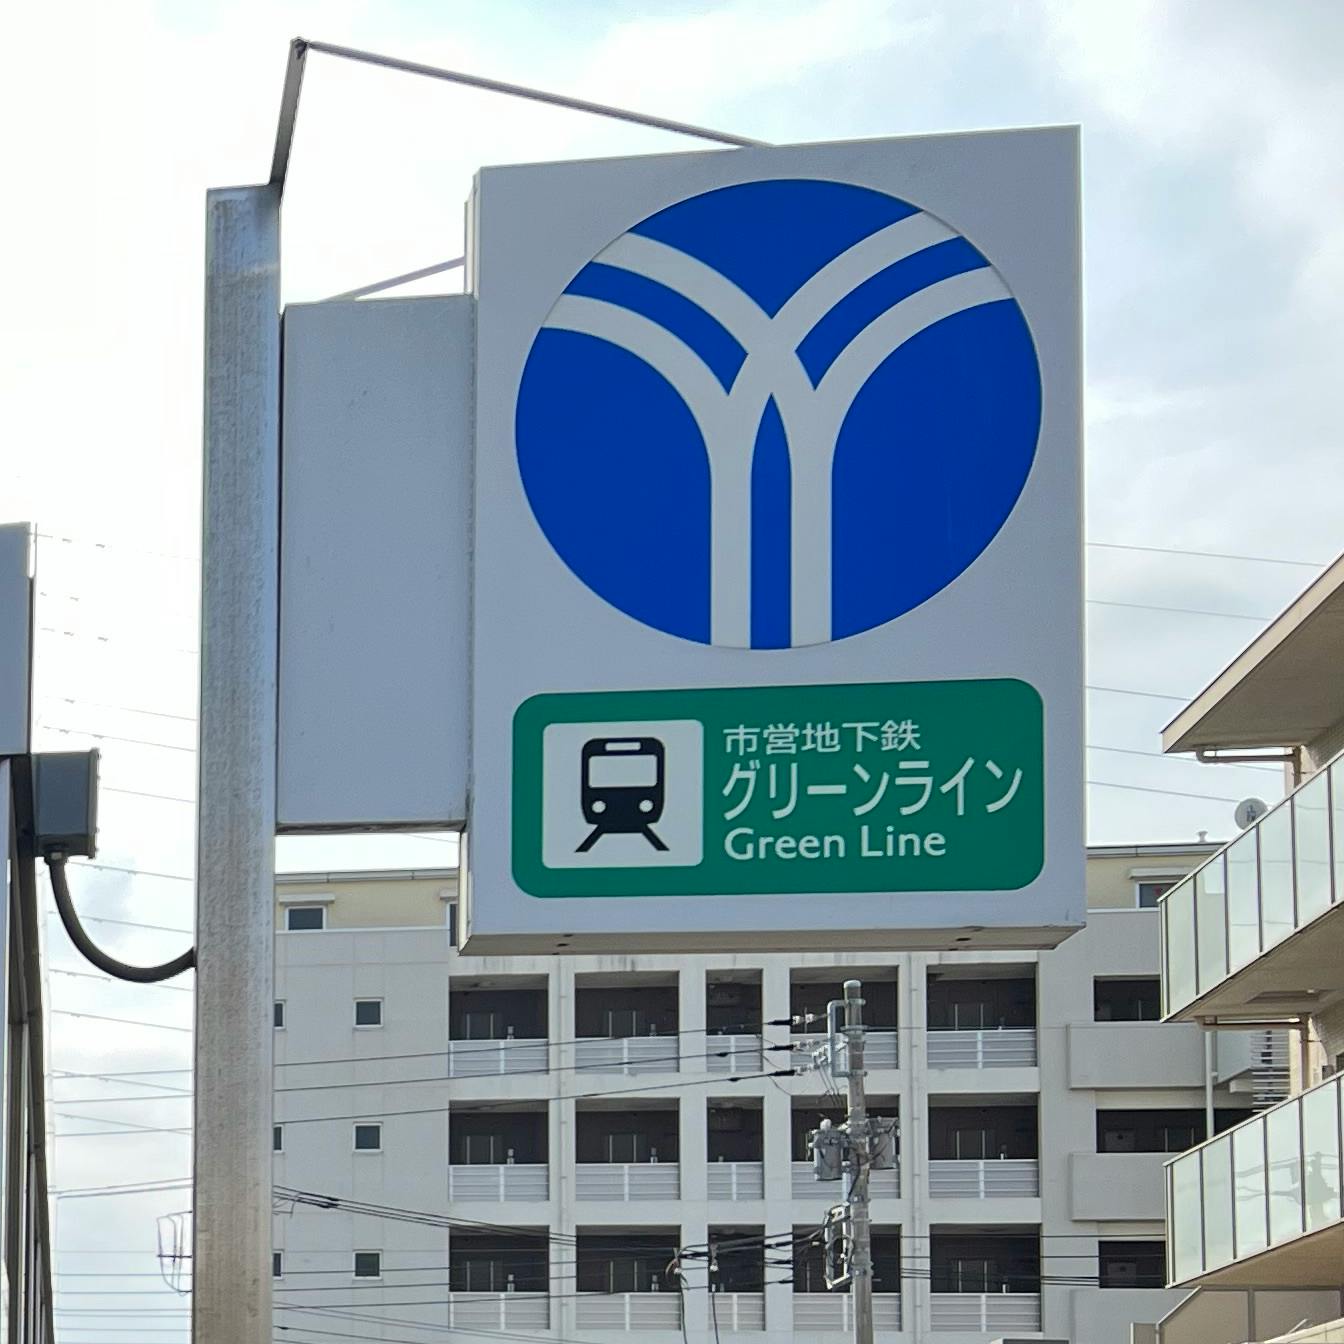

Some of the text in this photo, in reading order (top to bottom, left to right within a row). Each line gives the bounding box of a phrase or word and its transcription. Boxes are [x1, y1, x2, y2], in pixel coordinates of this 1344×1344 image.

[723, 719, 921, 755] 市営地下鉄
[721, 757, 1024, 822] グリーンライン
[724, 825, 947, 861] Green Line
